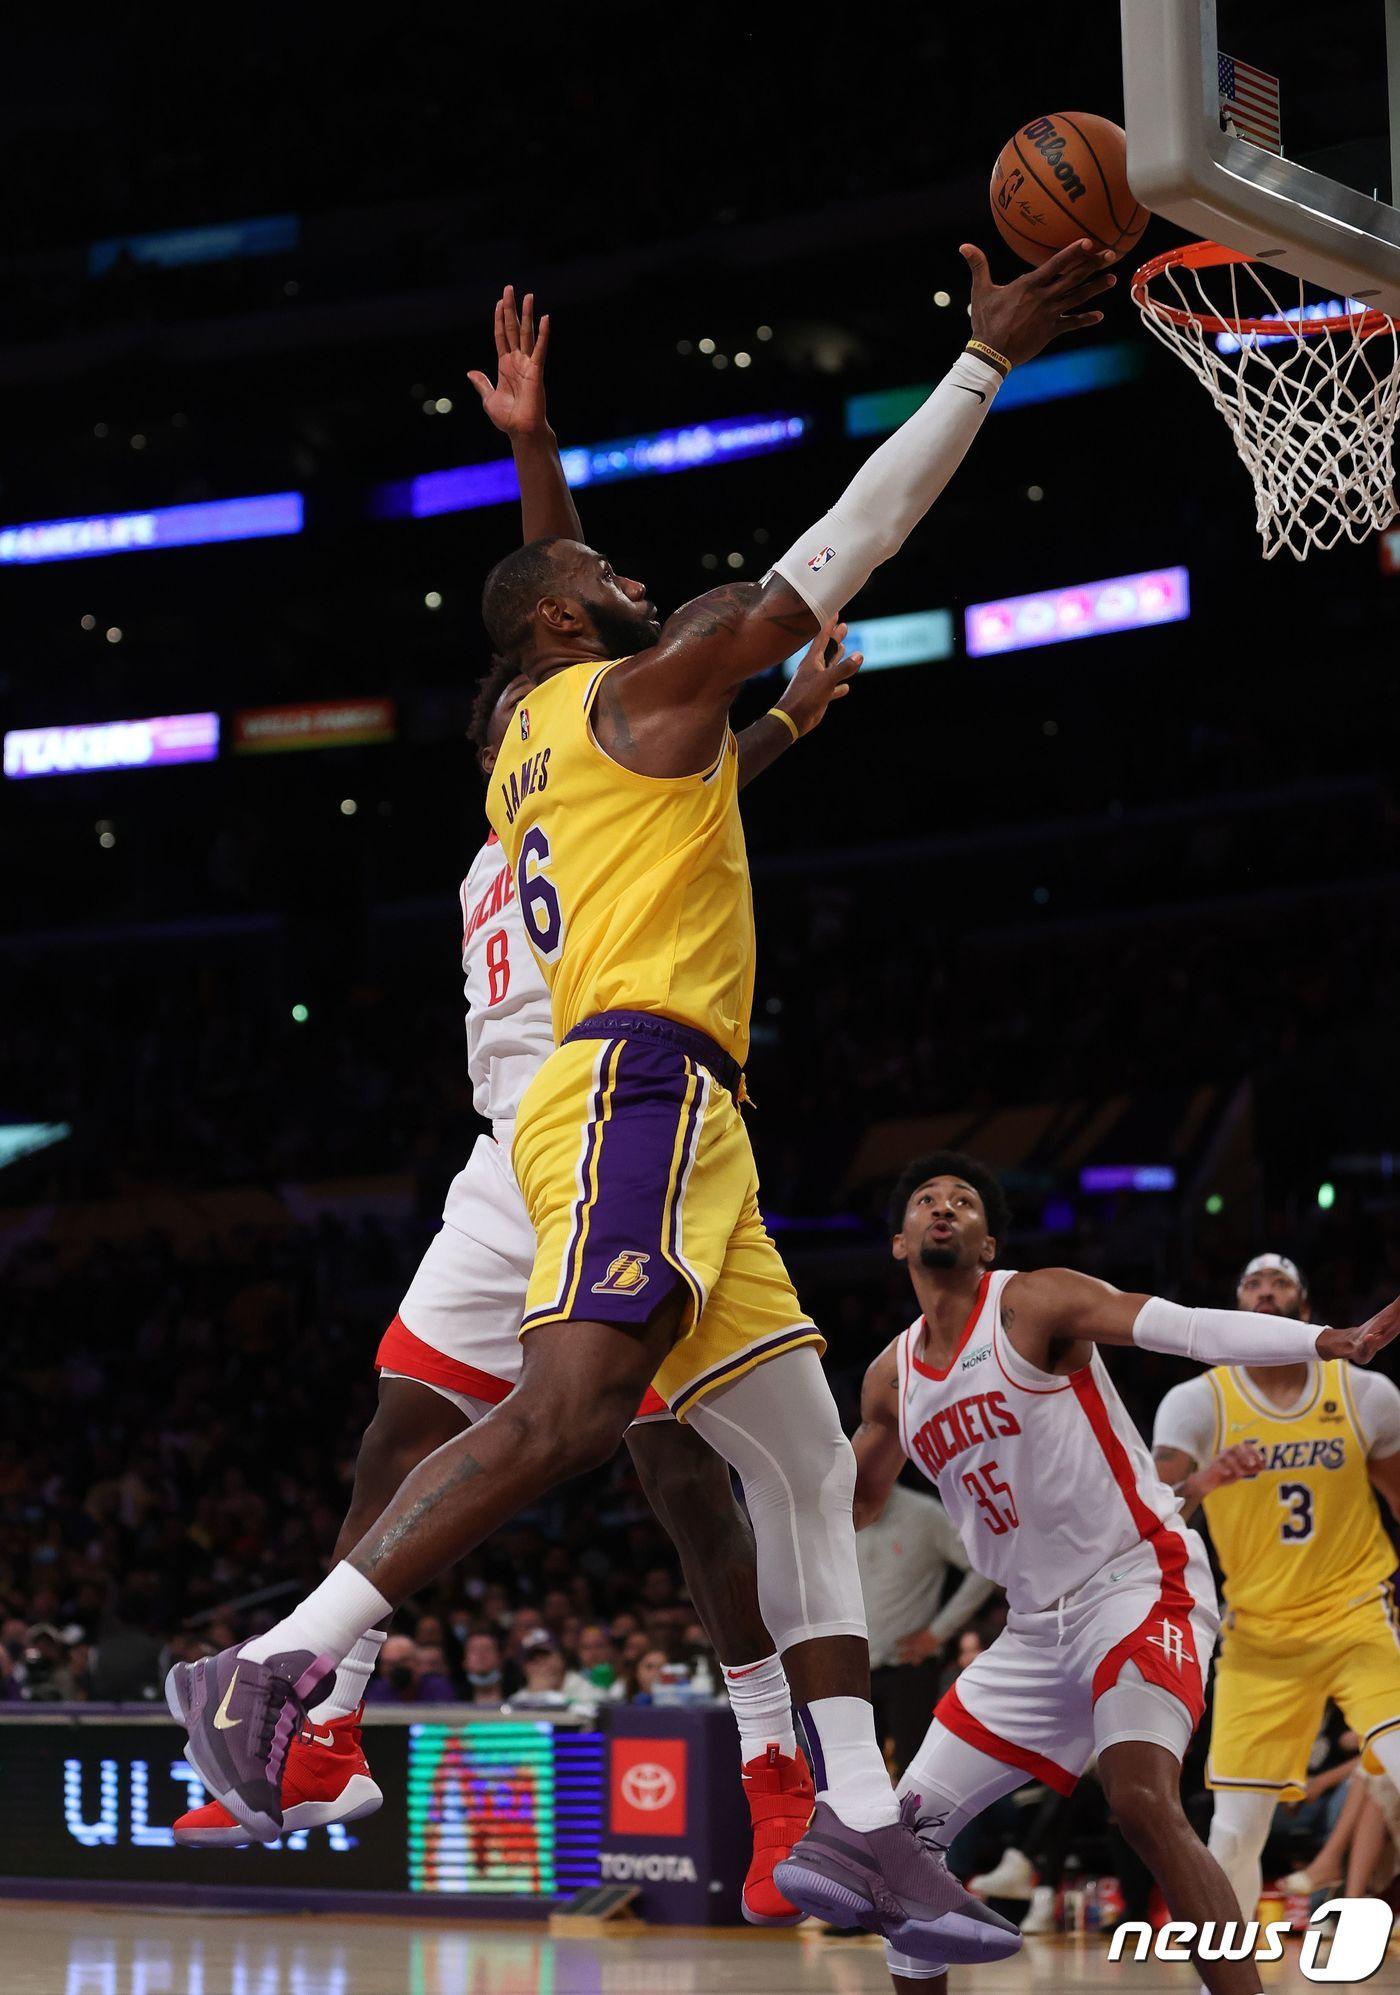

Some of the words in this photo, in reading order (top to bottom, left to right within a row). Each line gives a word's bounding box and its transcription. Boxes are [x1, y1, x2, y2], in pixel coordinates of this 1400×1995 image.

[1022, 117, 1087, 204] Wilson
[501, 747, 551, 825] JAMES
[515, 822, 567, 966] 6
[486, 928, 511, 1007] 8
[961, 1347, 993, 1371] MONEY
[911, 1390, 1022, 1481] ROCKETS
[962, 1460, 1020, 1536] 35
[1278, 1482, 1316, 1545] 3
[597, 1852, 698, 1883] TOYOTA
